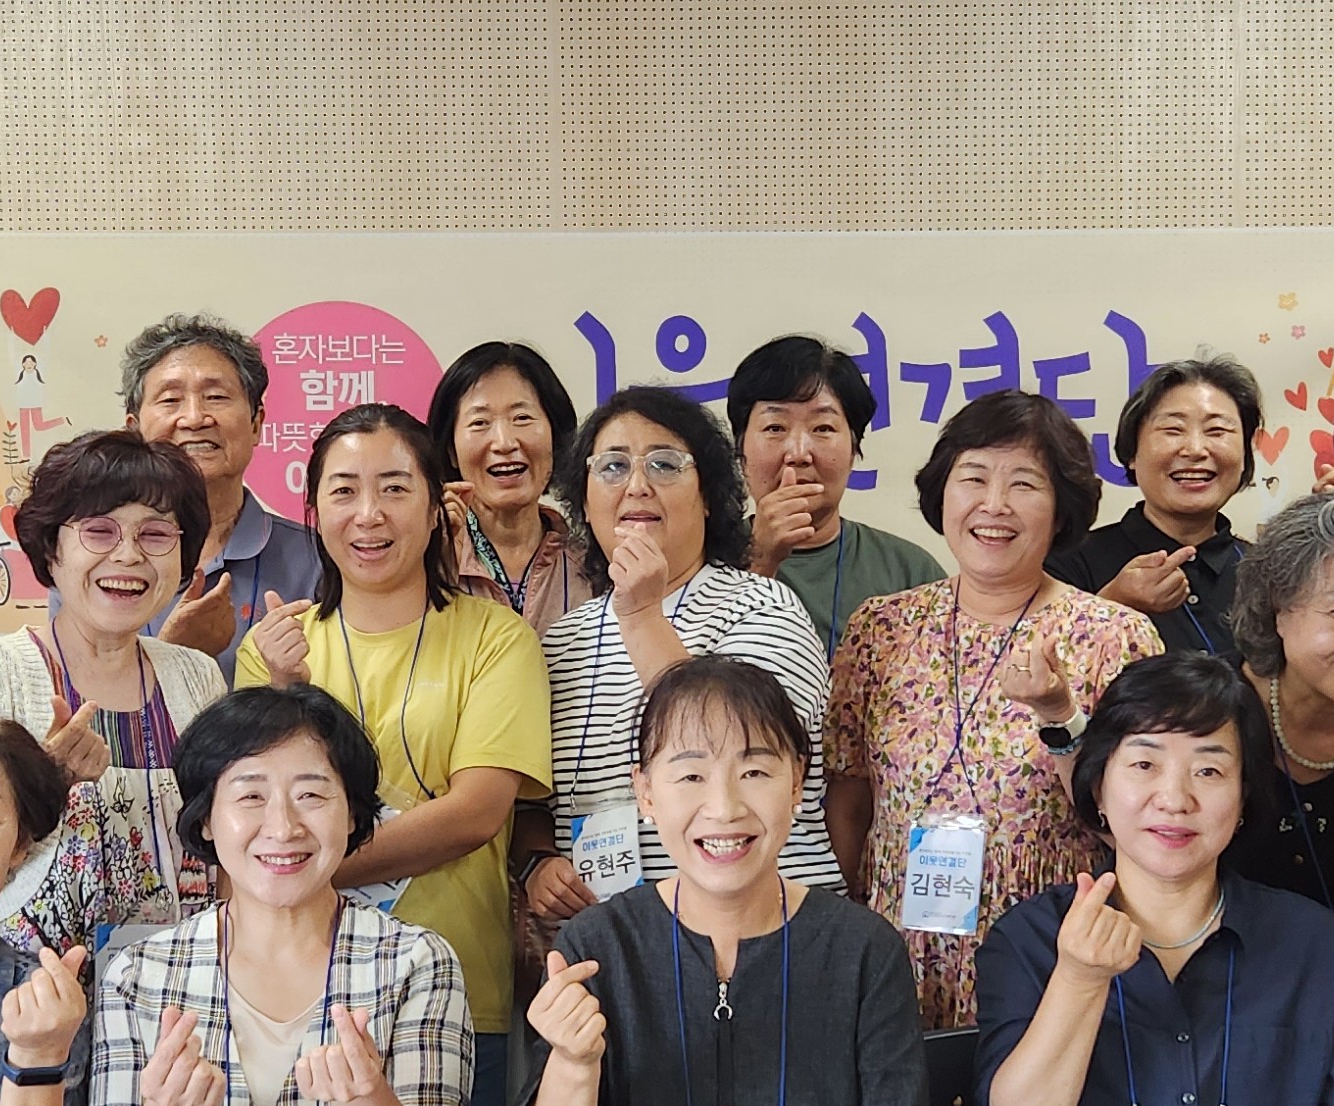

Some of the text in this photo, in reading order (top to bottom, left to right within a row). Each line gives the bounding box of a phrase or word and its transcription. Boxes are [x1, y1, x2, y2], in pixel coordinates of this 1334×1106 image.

[271, 333, 406, 364] 혼자보다는
[582, 833, 624, 852] 이웃연결단
[578, 850, 636, 883] 유현주
[919, 855, 967, 868] 이웃연결단
[911, 873, 975, 900] 김현숙
